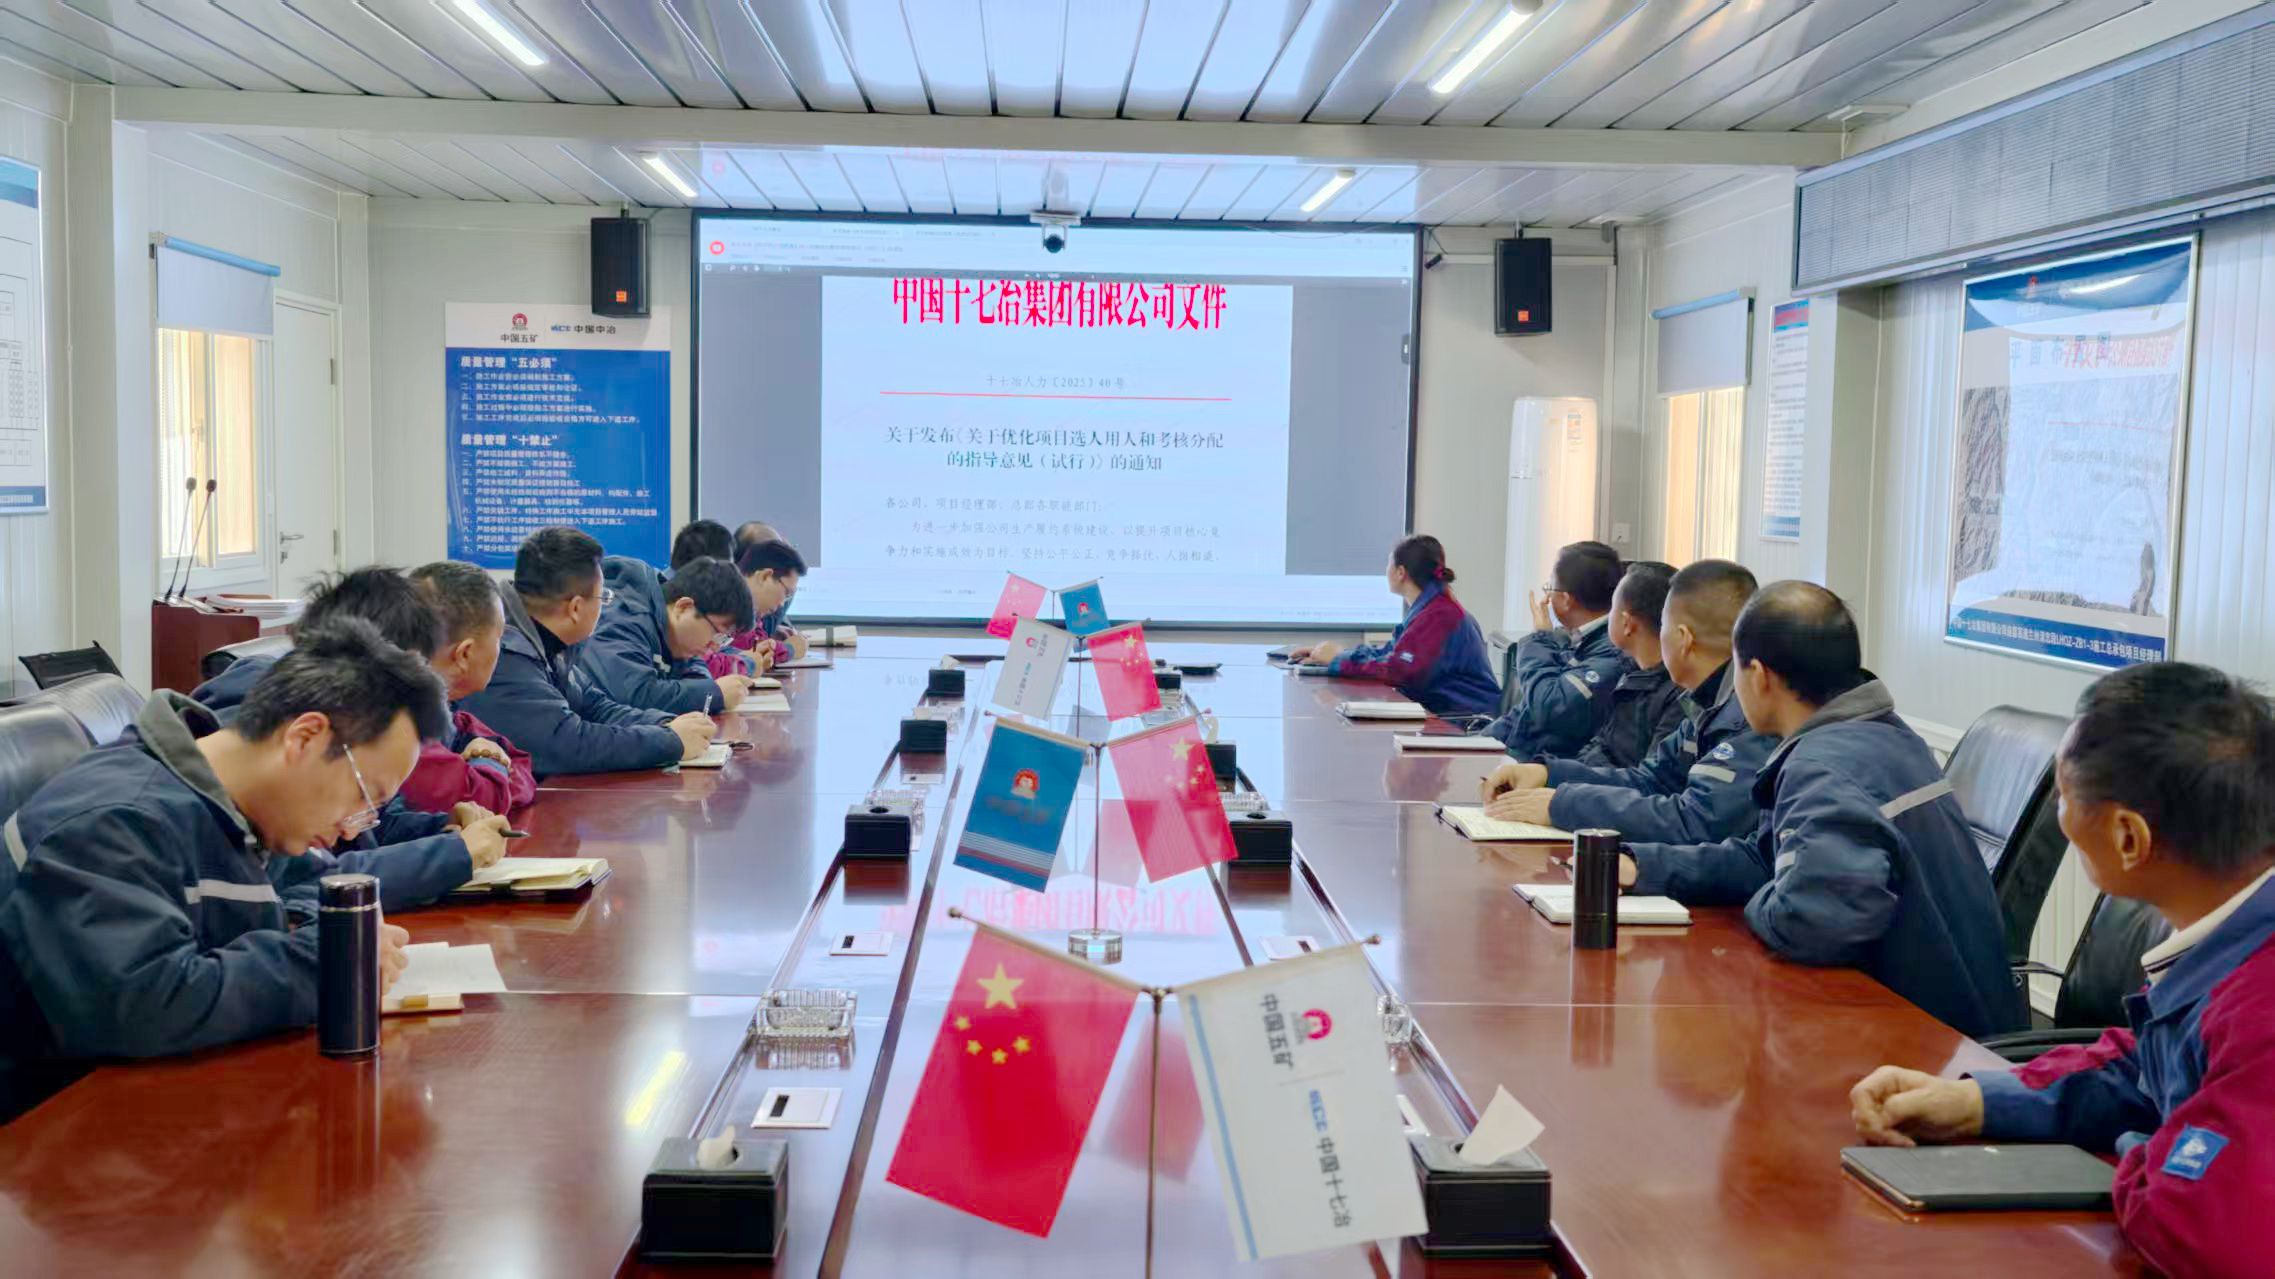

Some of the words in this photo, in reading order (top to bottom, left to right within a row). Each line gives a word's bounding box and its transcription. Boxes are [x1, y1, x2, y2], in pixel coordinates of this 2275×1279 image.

[574, 324, 616, 334] 中国中冶
[892, 277, 1227, 331] 中国十七冶集团有限公司文件
[500, 333, 539, 343] 中国五矿
[1259, 993, 1296, 1070] 中国五矿
[1316, 1136, 1354, 1229] 中国十七冶
